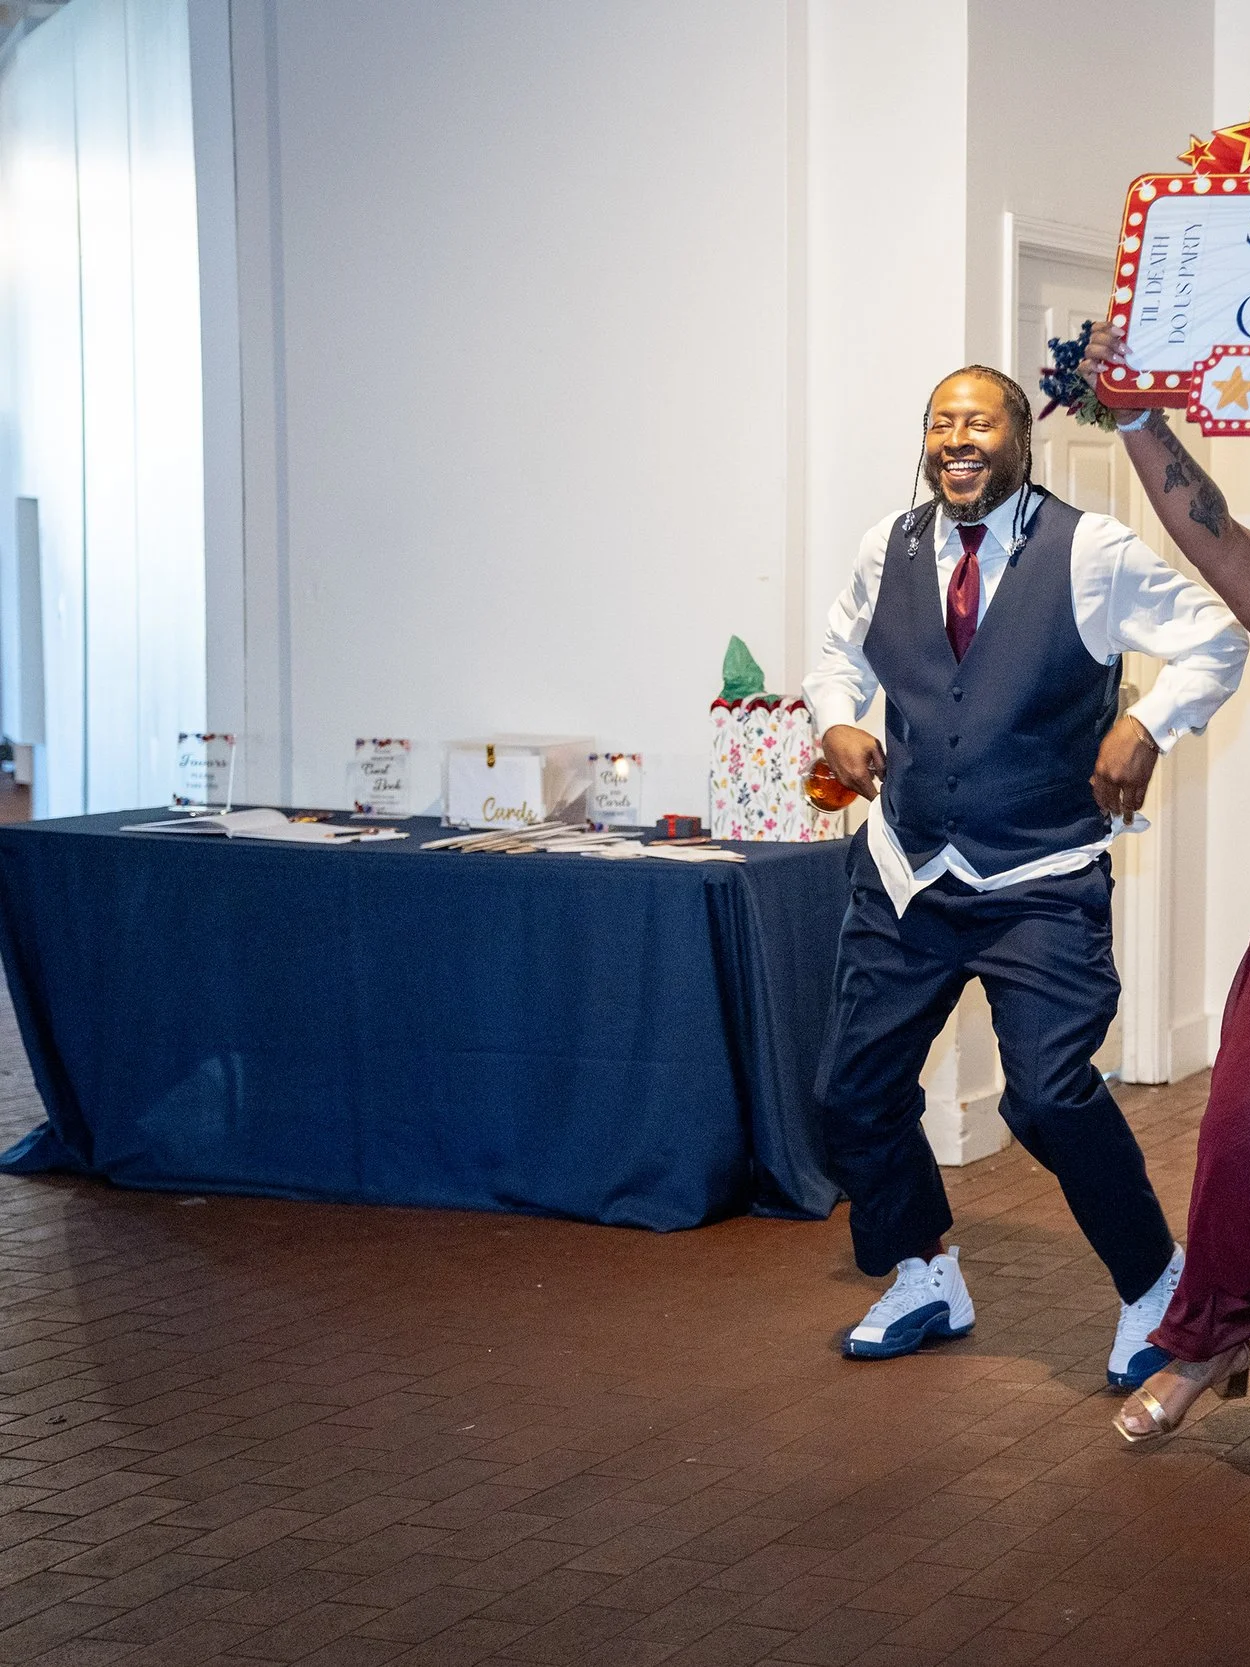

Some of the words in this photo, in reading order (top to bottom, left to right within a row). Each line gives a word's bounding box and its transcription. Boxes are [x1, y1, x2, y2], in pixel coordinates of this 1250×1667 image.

[1178, 224, 1203, 277] PARTY
[1145, 236, 1170, 295] DEATH
[1174, 282, 1193, 308] US
[1140, 300, 1161, 327] TIL
[1168, 313, 1188, 343] DO
[482, 796, 538, 825] Cards
